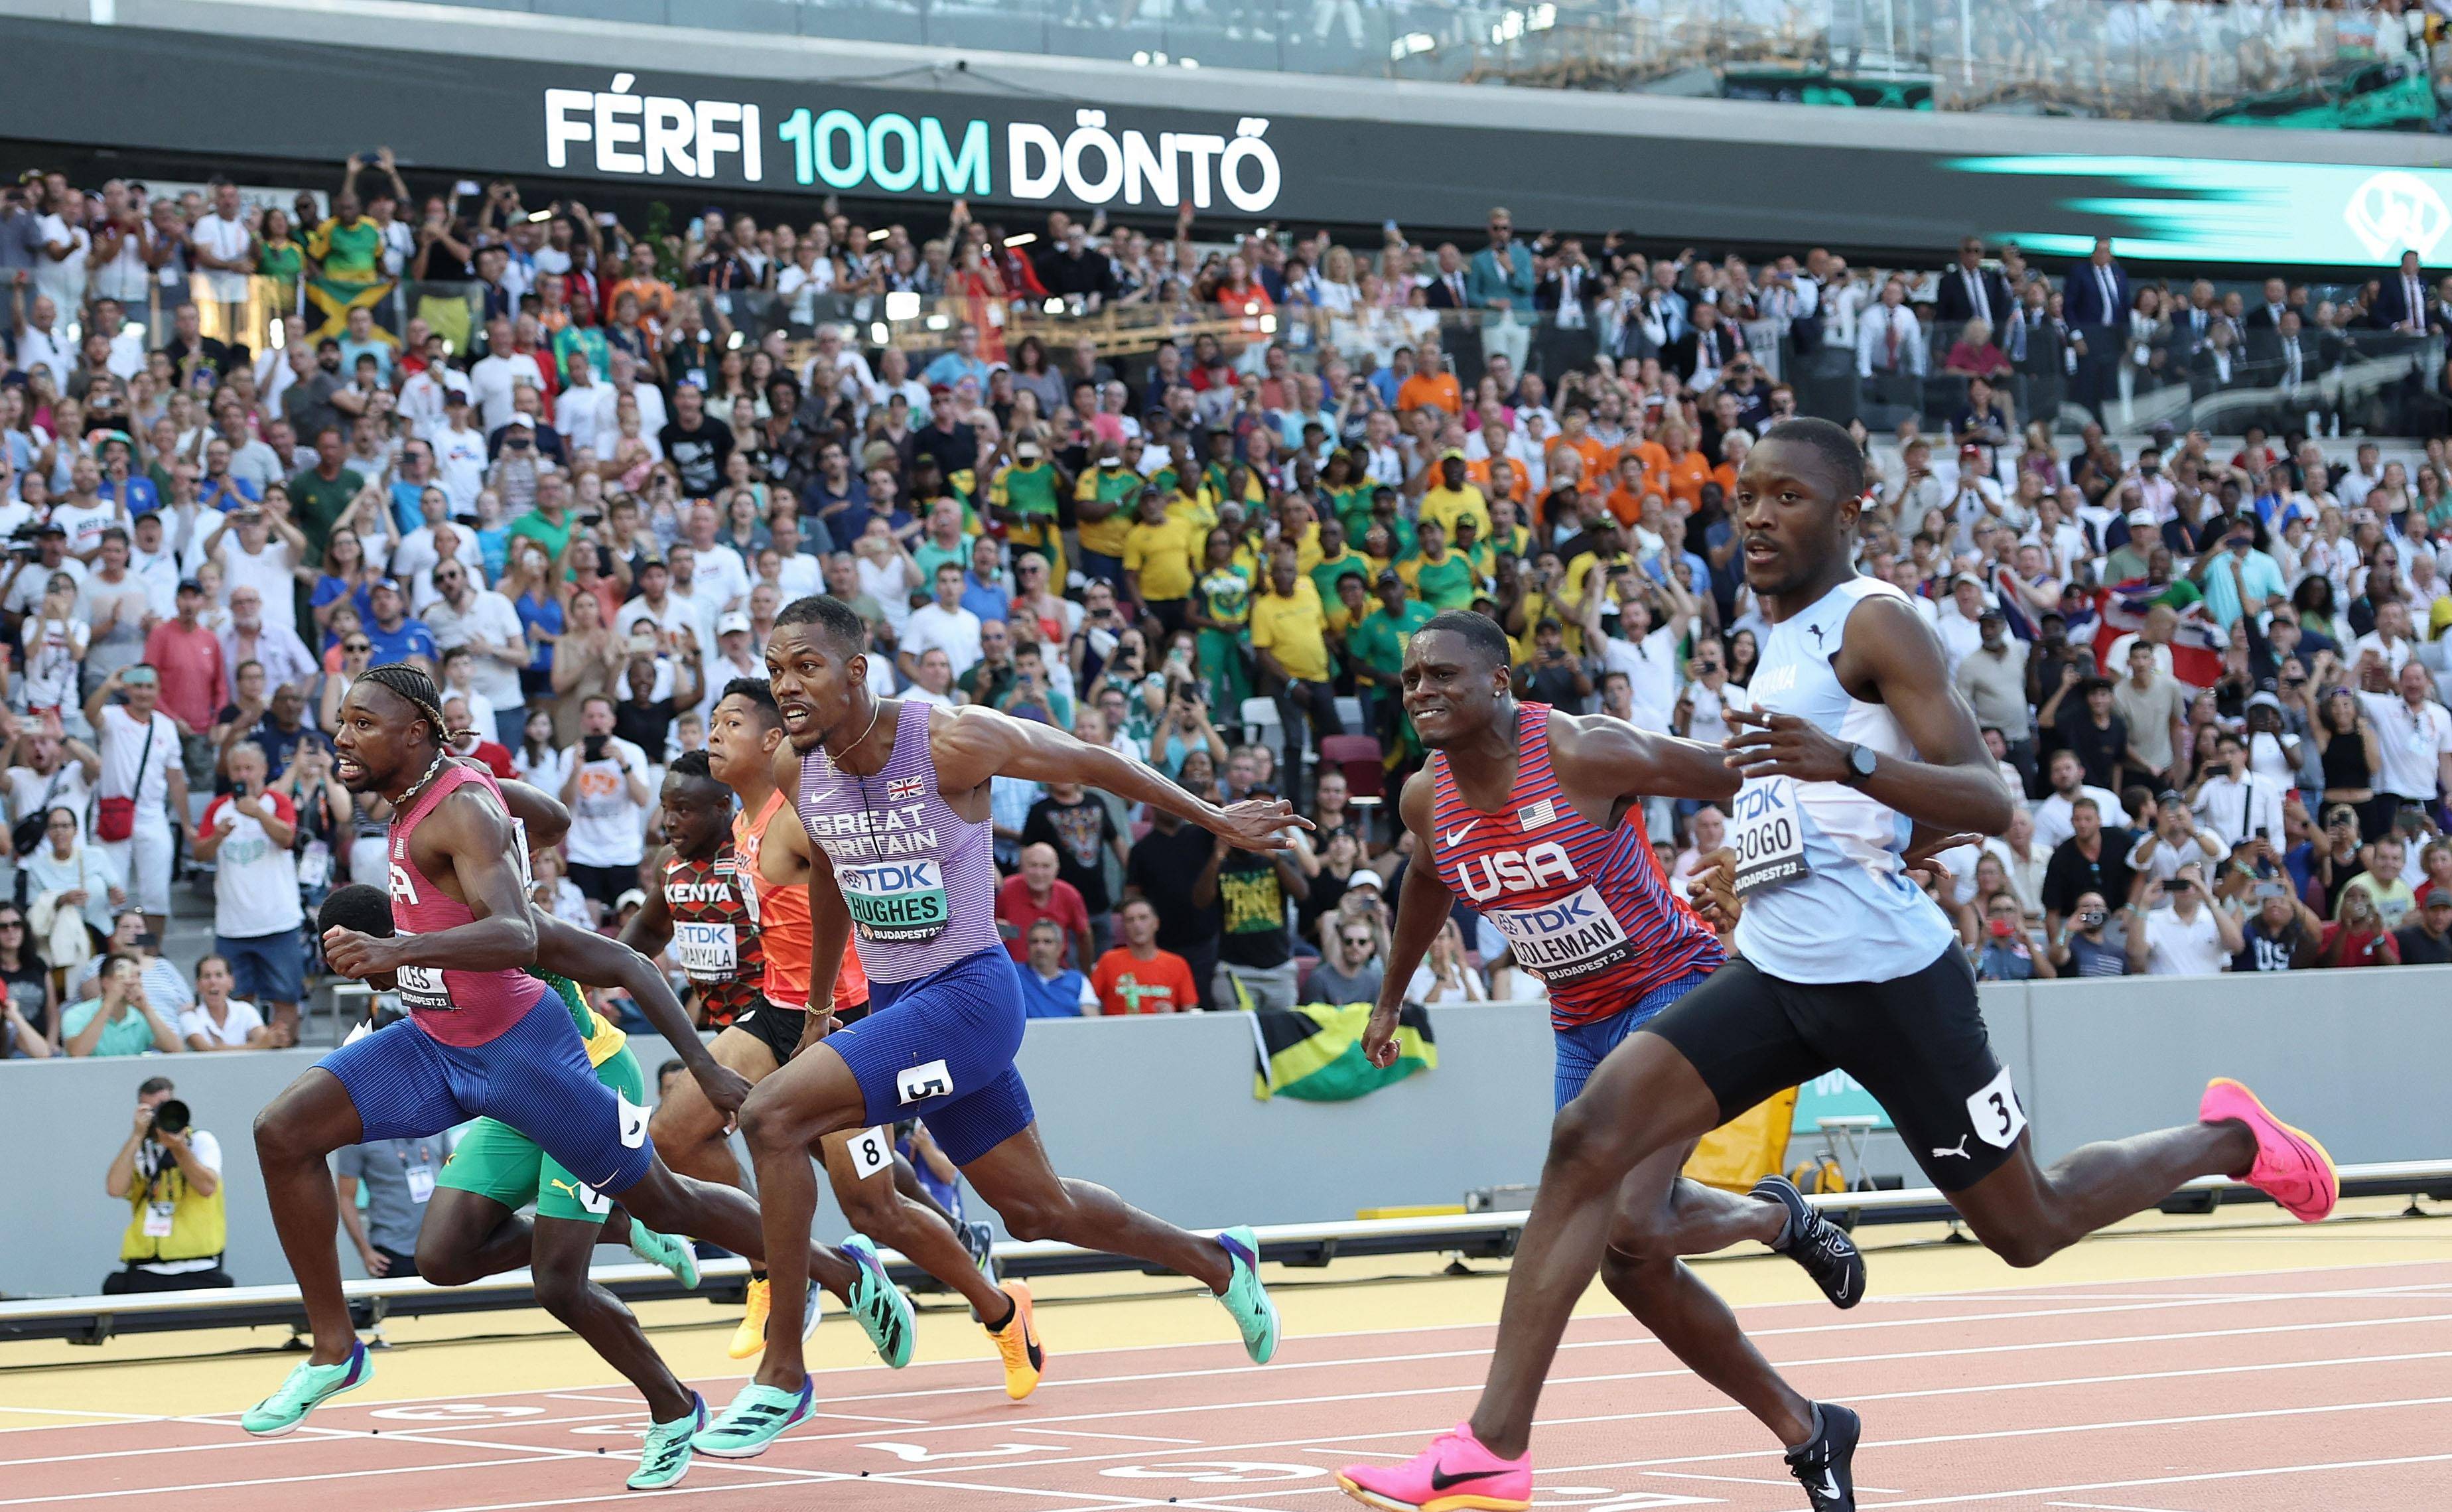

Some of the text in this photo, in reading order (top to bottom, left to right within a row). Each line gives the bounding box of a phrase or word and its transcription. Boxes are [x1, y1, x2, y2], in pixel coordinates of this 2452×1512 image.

[545, 73, 1281, 212] FÉRFI 100M DÖNTŐ
[1736, 778, 1785, 824] TDK
[811, 803, 925, 836] GREAT
[819, 828, 939, 857] BRITAIN
[858, 862, 933, 891] TDK
[1457, 841, 1579, 902] USA
[1782, 861, 1797, 876] 23
[663, 882, 733, 904] KENYA
[851, 896, 939, 923] HUGHES
[1510, 894, 1596, 935] TDK
[684, 926, 728, 945] TDK
[874, 928, 927, 940] BUDAPEST
[1511, 918, 1617, 966] COLEMAN
[1547, 948, 1626, 981] BUDAPEST 23
[401, 991, 447, 1006] BUDAPEST 23
[907, 1078, 945, 1100] 5
[1988, 1091, 2012, 1137] 3
[862, 1138, 880, 1166] 8
